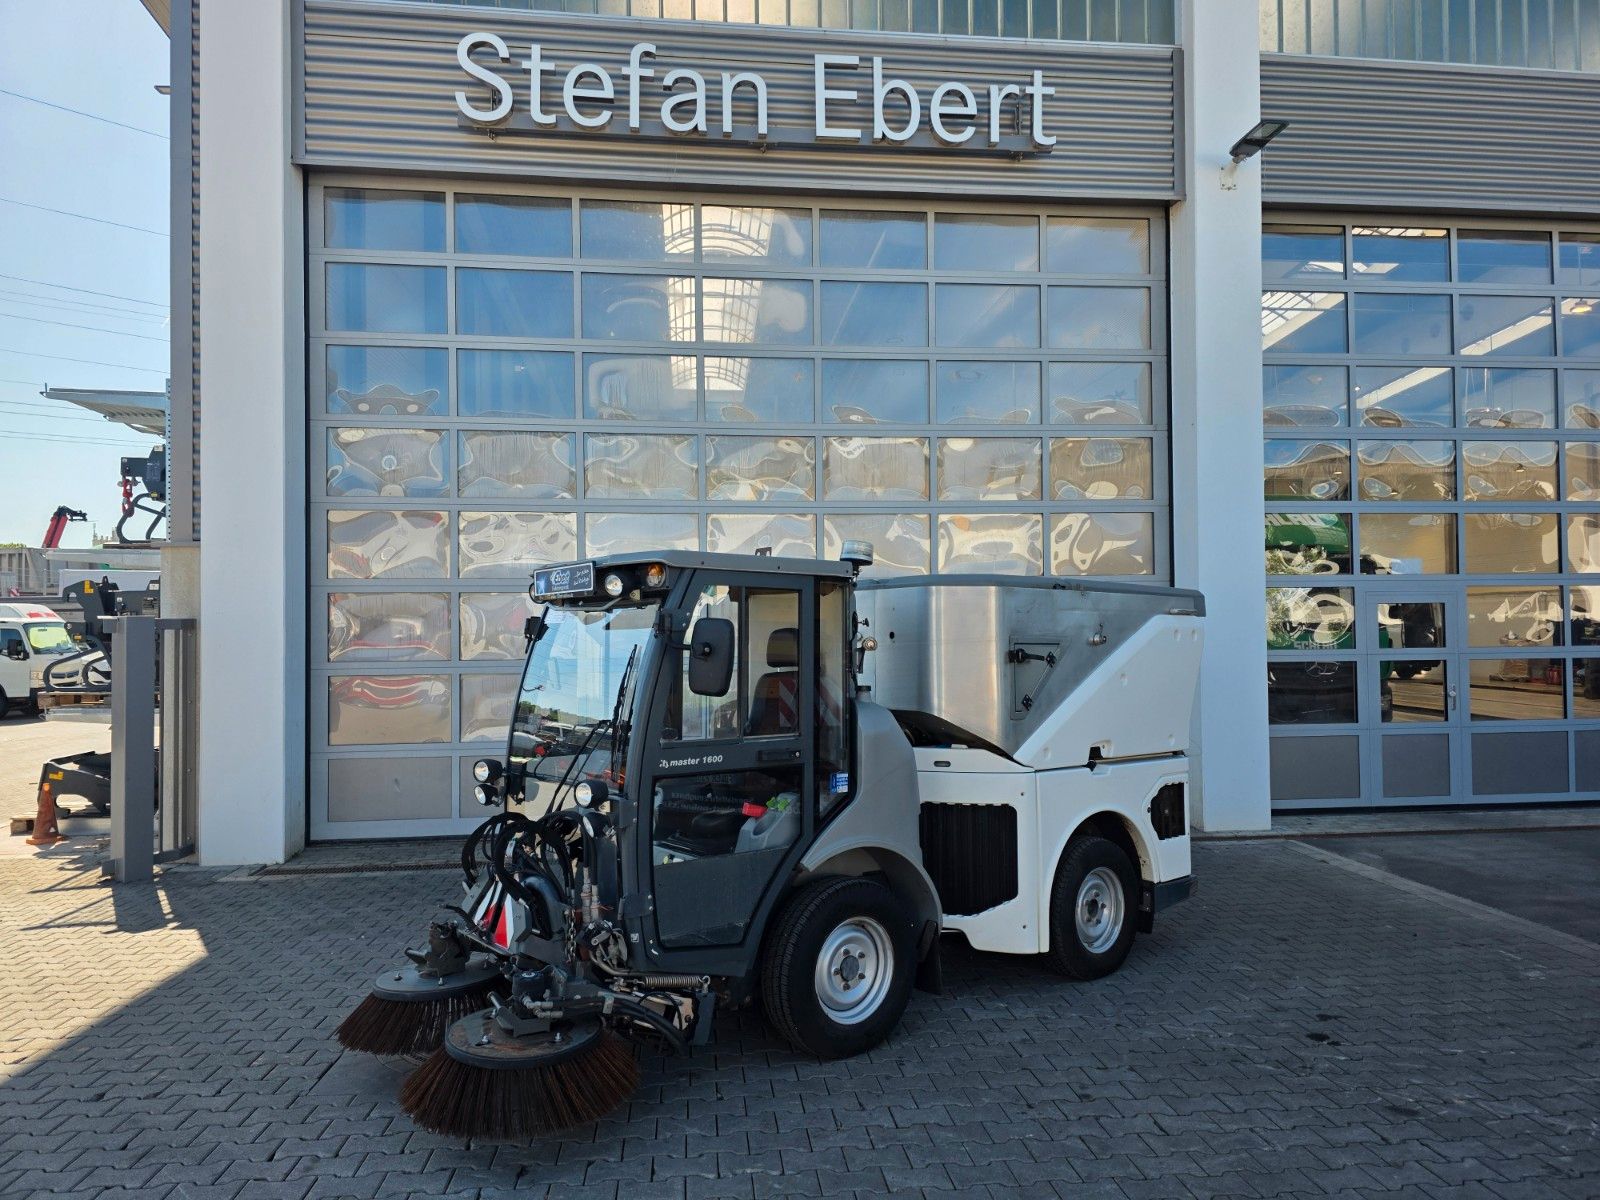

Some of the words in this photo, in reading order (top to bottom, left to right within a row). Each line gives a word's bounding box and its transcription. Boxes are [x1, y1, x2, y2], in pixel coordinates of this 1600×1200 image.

[454, 32, 768, 136] Stefan
[814, 54, 1057, 147] Ebert
[702, 754, 723, 764] 1600
